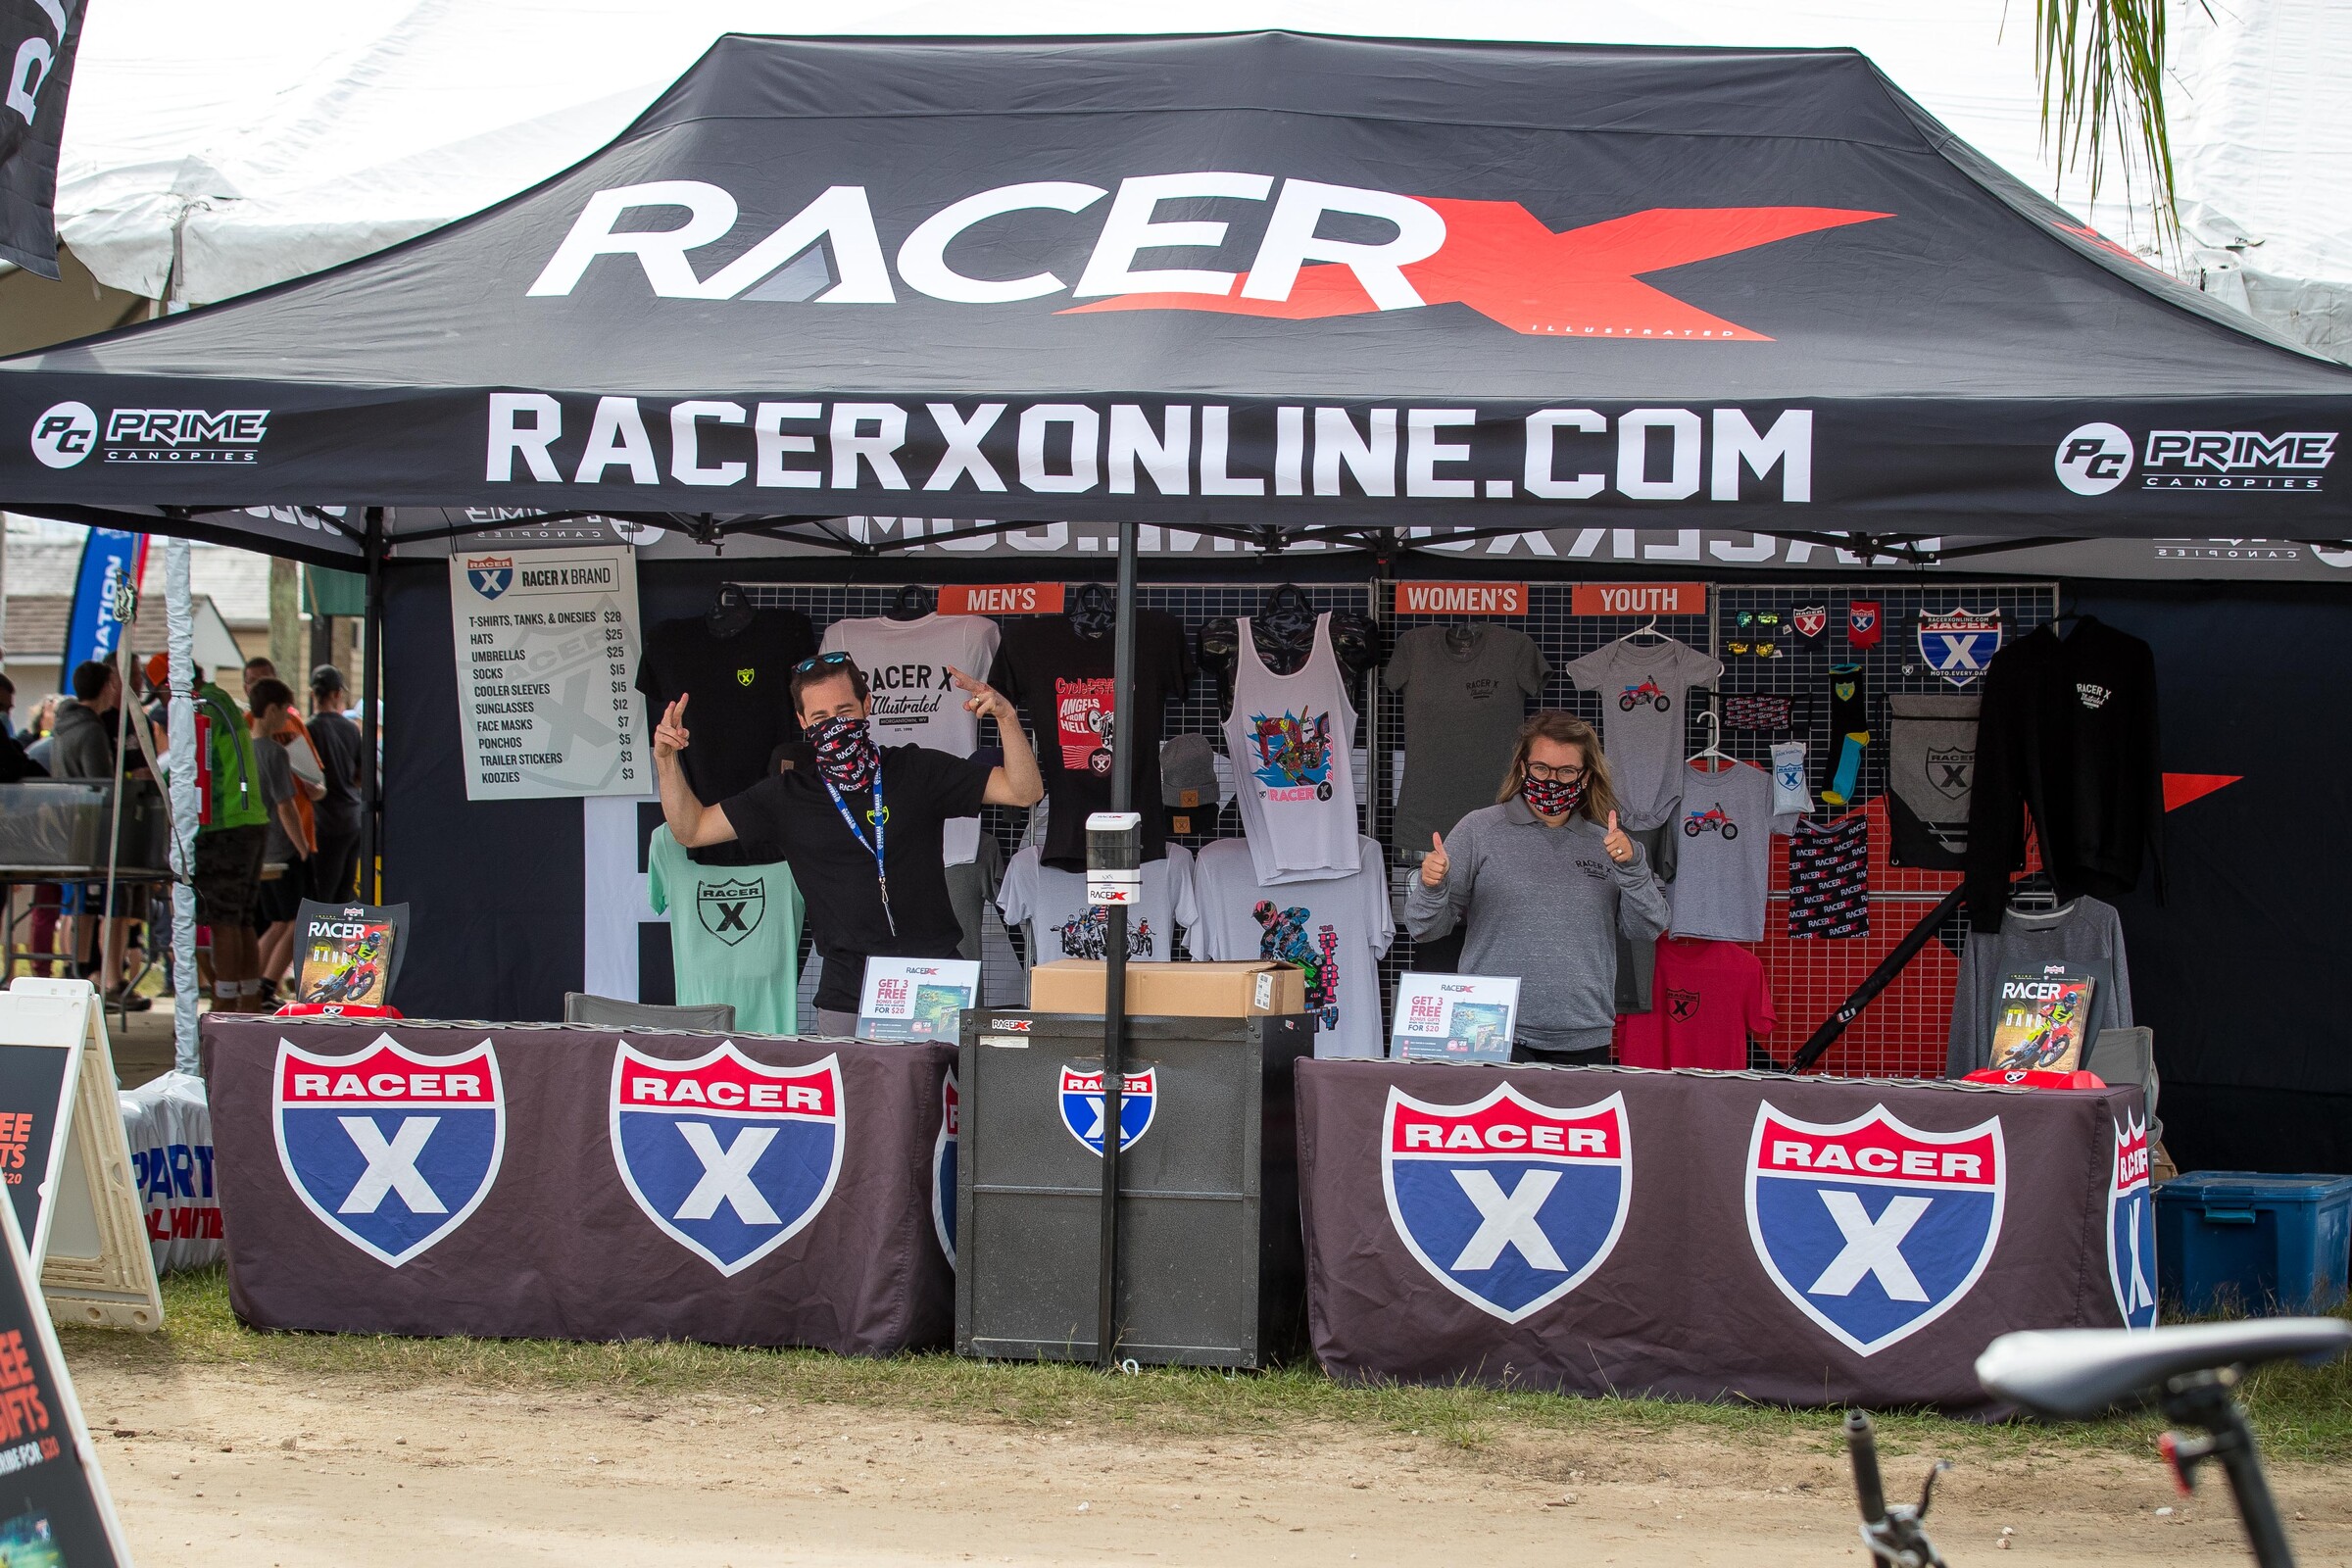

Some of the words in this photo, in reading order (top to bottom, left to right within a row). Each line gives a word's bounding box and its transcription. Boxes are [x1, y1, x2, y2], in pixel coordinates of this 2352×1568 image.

[1532, 324, 1734, 337] ILLUSTRATED
[106, 409, 270, 447] PRIME
[108, 452, 255, 461] CANOPIES
[486, 393, 1813, 503] RACERXONLINE.COM
[2143, 430, 2339, 472] PRIME
[2146, 477, 2319, 488] CANOPIES
[479, 570, 503, 592] X
[522, 570, 559, 587] RACER
[561, 569, 569, 585] X
[571, 567, 611, 584] BRAND
[967, 588, 1037, 612] MEN'S
[1407, 587, 1517, 612] WOMEN'S
[1600, 588, 1678, 612] YOUTH
[468, 614, 513, 627] T-SHIRTS,
[514, 613, 546, 626] TANKS,
[548, 614, 556, 624] &
[558, 612, 597, 623] ONESIES
[604, 611, 621, 624] $28
[1802, 616, 1818, 631] X
[1855, 616, 1868, 628] X
[470, 633, 494, 645] HATS
[605, 629, 623, 642] $25
[471, 649, 525, 662] UMBRELLAS
[607, 646, 624, 660] $25
[1939, 635, 1980, 669] X
[472, 667, 504, 680] SOCKS
[610, 663, 625, 676] $15
[938, 666, 953, 692] X
[474, 685, 511, 698] COOLER
[511, 683, 551, 696] SLEEVES
[612, 681, 627, 694] $15
[1466, 678, 1492, 690] RACER
[2076, 683, 2103, 696] RACER
[2103, 689, 2112, 700] X
[475, 702, 534, 714] SUNGLASSES
[612, 698, 628, 711] $12
[870, 693, 942, 715] Illustrated
[1060, 698, 1100, 718] ANGELS
[477, 720, 500, 732] FACE
[501, 719, 533, 731] MASKS
[617, 716, 629, 728] $7
[1066, 712, 1085, 722] FROM
[1060, 719, 1090, 733] HELL
[478, 737, 522, 750] PONCHOS
[618, 734, 631, 747] $5
[480, 755, 517, 767] TRAILER
[518, 753, 563, 765] STICKERS
[620, 751, 633, 763] $3
[481, 771, 520, 784] KOOZIES
[621, 768, 634, 781] $3
[1784, 772, 1798, 785] X
[1940, 765, 1968, 787] X
[1270, 787, 1314, 802] RACER
[703, 886, 760, 898] RACER
[715, 902, 749, 932] X
[878, 979, 899, 988] GET
[903, 979, 908, 988] 3
[877, 988, 906, 999] FREE
[1412, 996, 1433, 1005] GET
[1438, 997, 1443, 1005] 3
[1411, 1005, 1442, 1017] FREE
[1672, 1000, 1690, 1016] X
[294, 1073, 480, 1098] RACER
[632, 1078, 822, 1110] RACER
[1405, 1123, 1607, 1153] RACER
[337, 1116, 449, 1213] X
[1772, 1140, 1982, 1179] RACER
[672, 1121, 783, 1224] X
[1449, 1168, 1569, 1272] X
[1807, 1189, 1934, 1302] X
[2129, 1197, 2154, 1315] X
